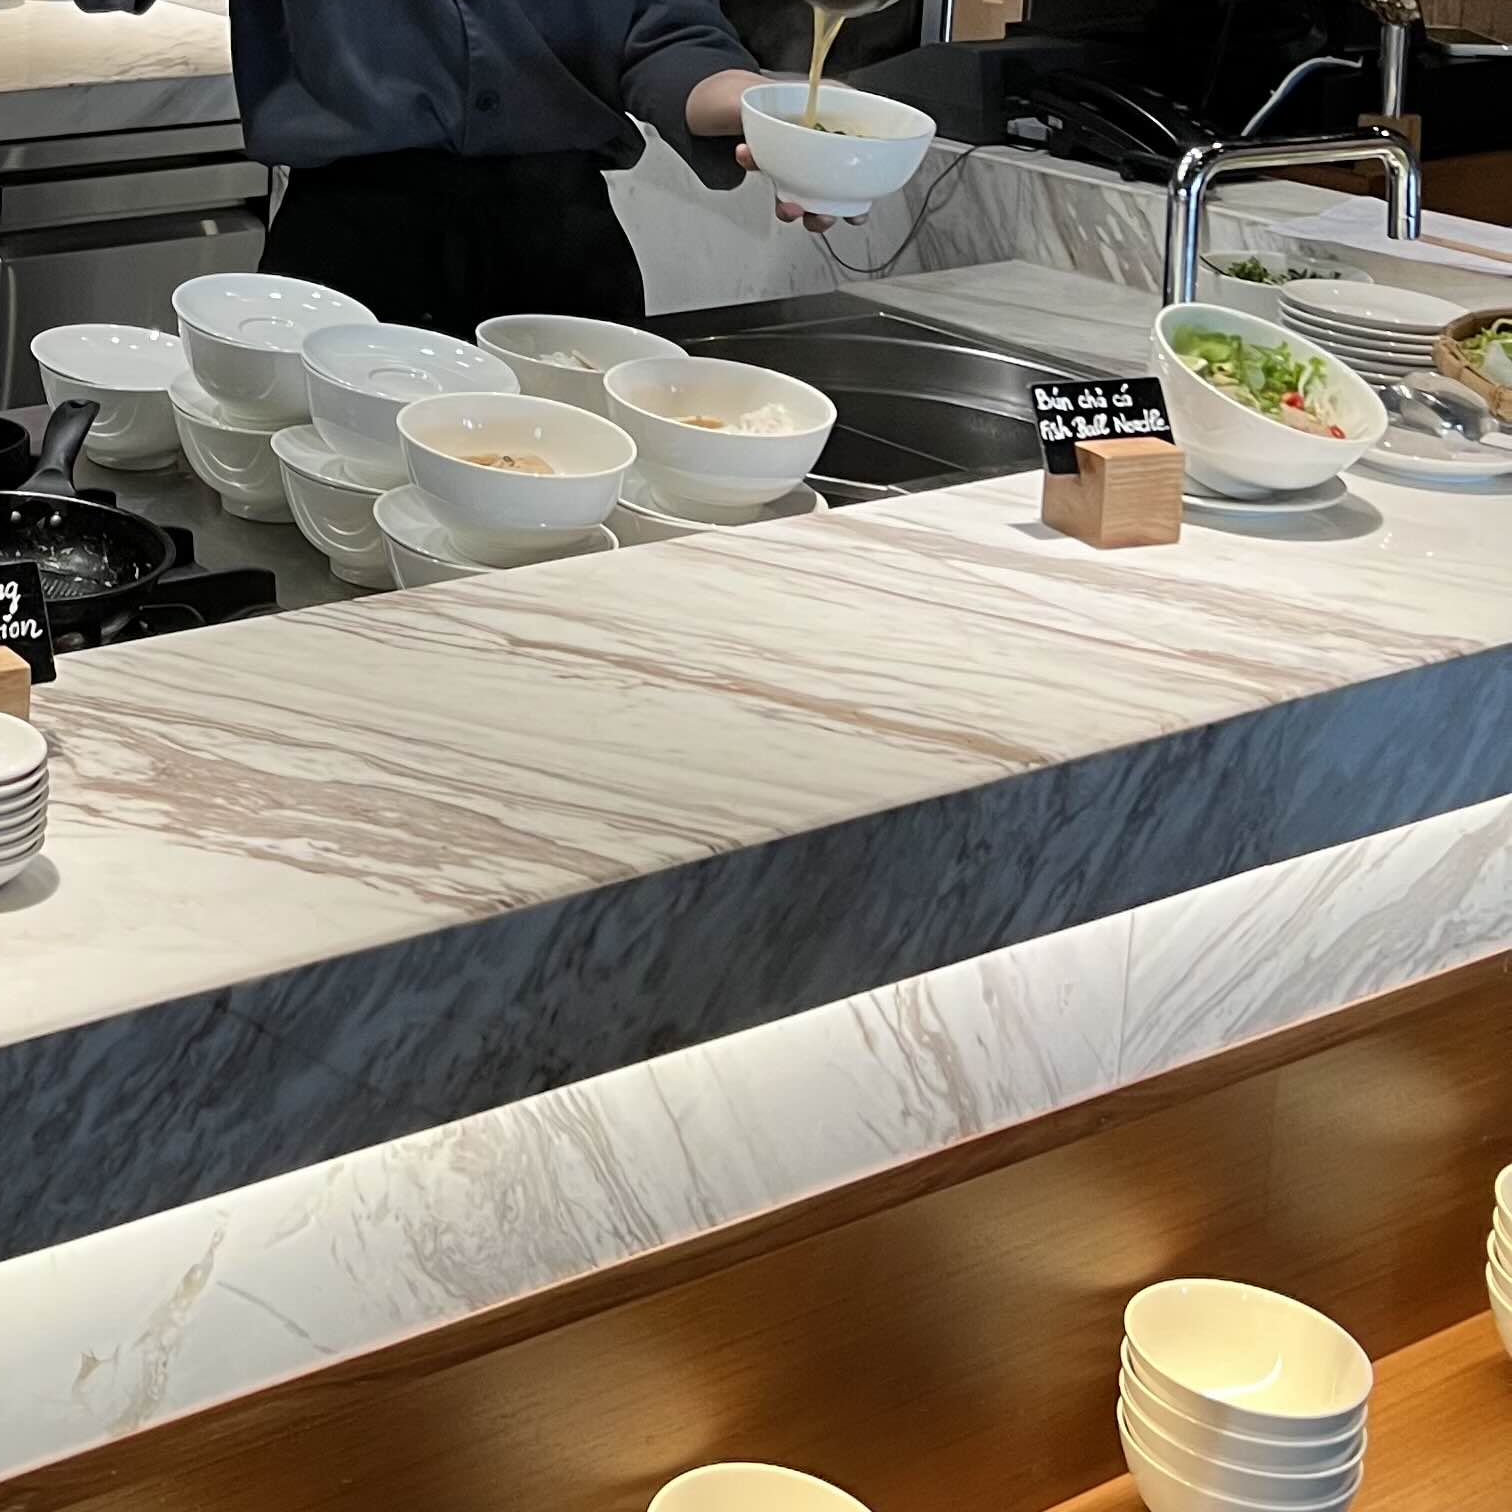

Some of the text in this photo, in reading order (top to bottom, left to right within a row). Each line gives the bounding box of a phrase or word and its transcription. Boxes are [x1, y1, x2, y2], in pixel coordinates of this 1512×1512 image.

[1112, 383, 1133, 407] cá
[1071, 413, 1110, 439] Ball
[1113, 408, 1170, 434] Noodle
